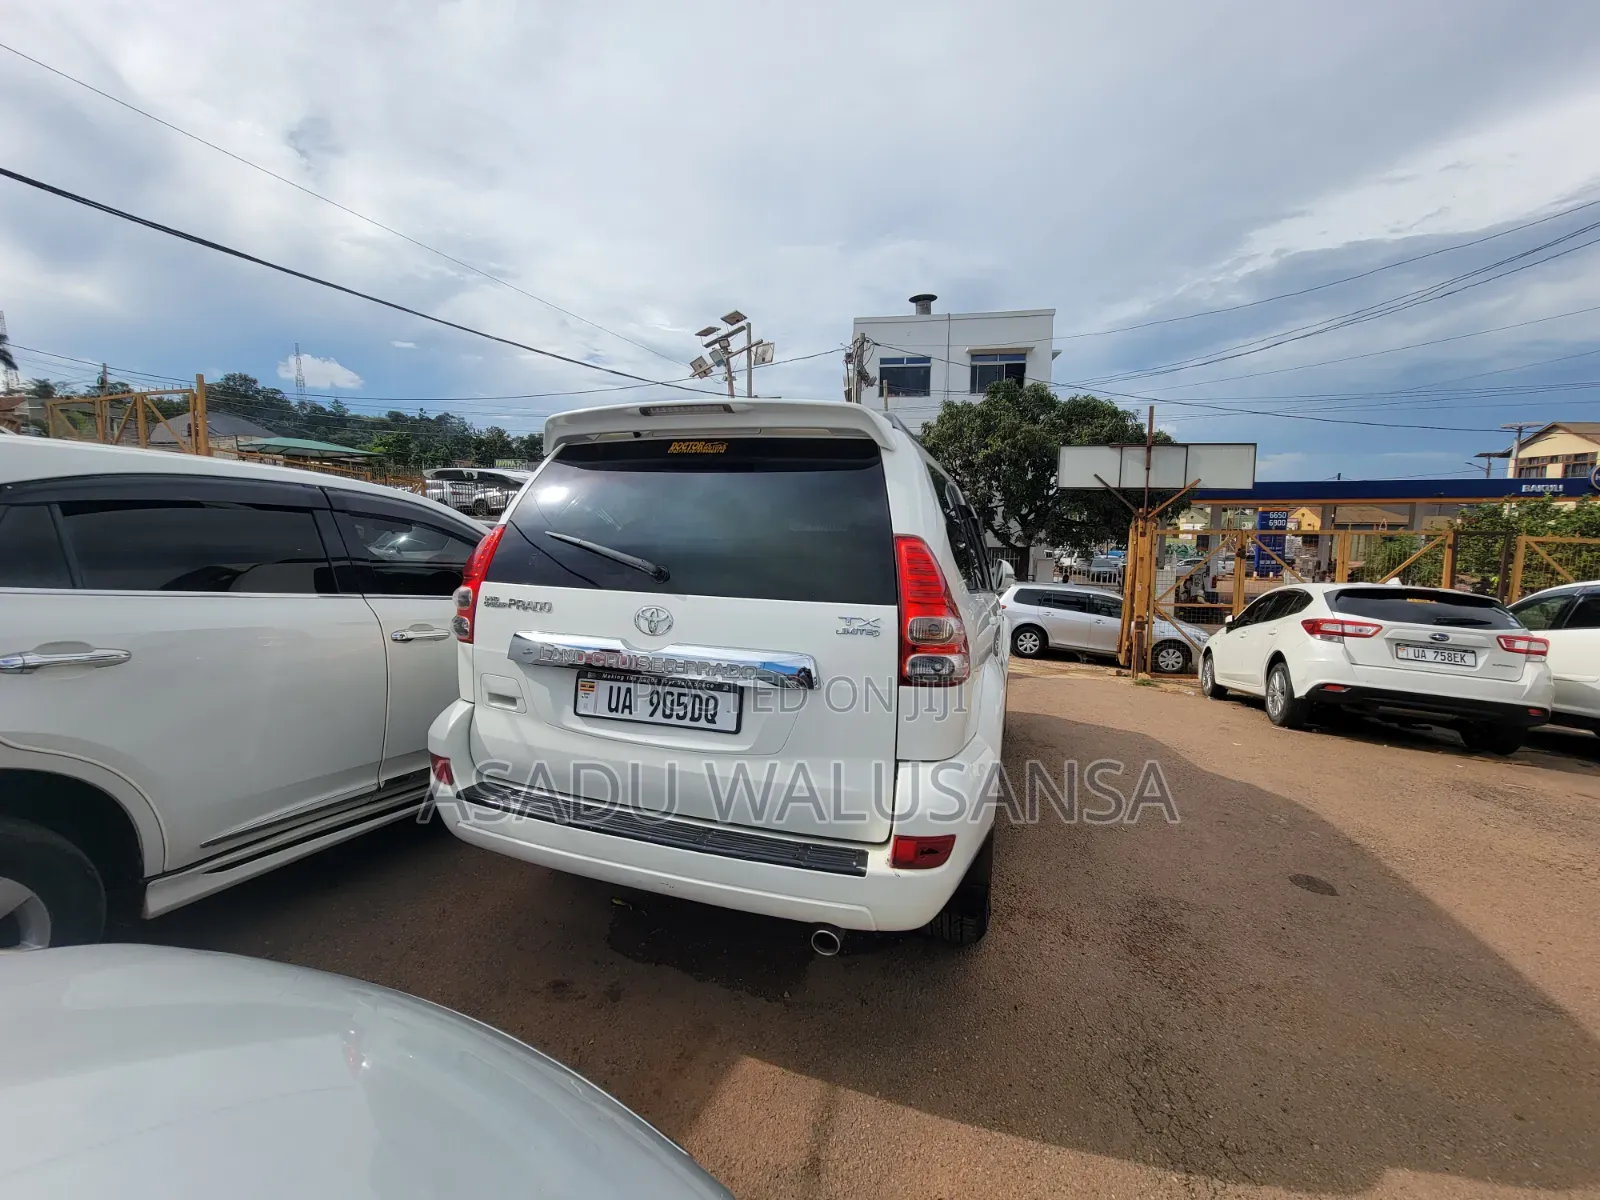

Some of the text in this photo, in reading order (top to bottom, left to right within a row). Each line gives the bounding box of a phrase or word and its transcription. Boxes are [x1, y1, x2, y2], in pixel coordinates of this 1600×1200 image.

[669, 441, 705, 450] DOCTOR
[1521, 484, 1564, 493] BAKULI
[1269, 511, 1287, 519] 6650
[1268, 519, 1286, 527] 6900
[507, 598, 554, 614] PRADO
[838, 616, 881, 629] TX
[540, 645, 759, 680] LAND CRUISER PRADO
[1413, 648, 1427, 660] UA
[1432, 650, 1467, 664] 758EK
[608, 685, 720, 725] UA 905DQ
